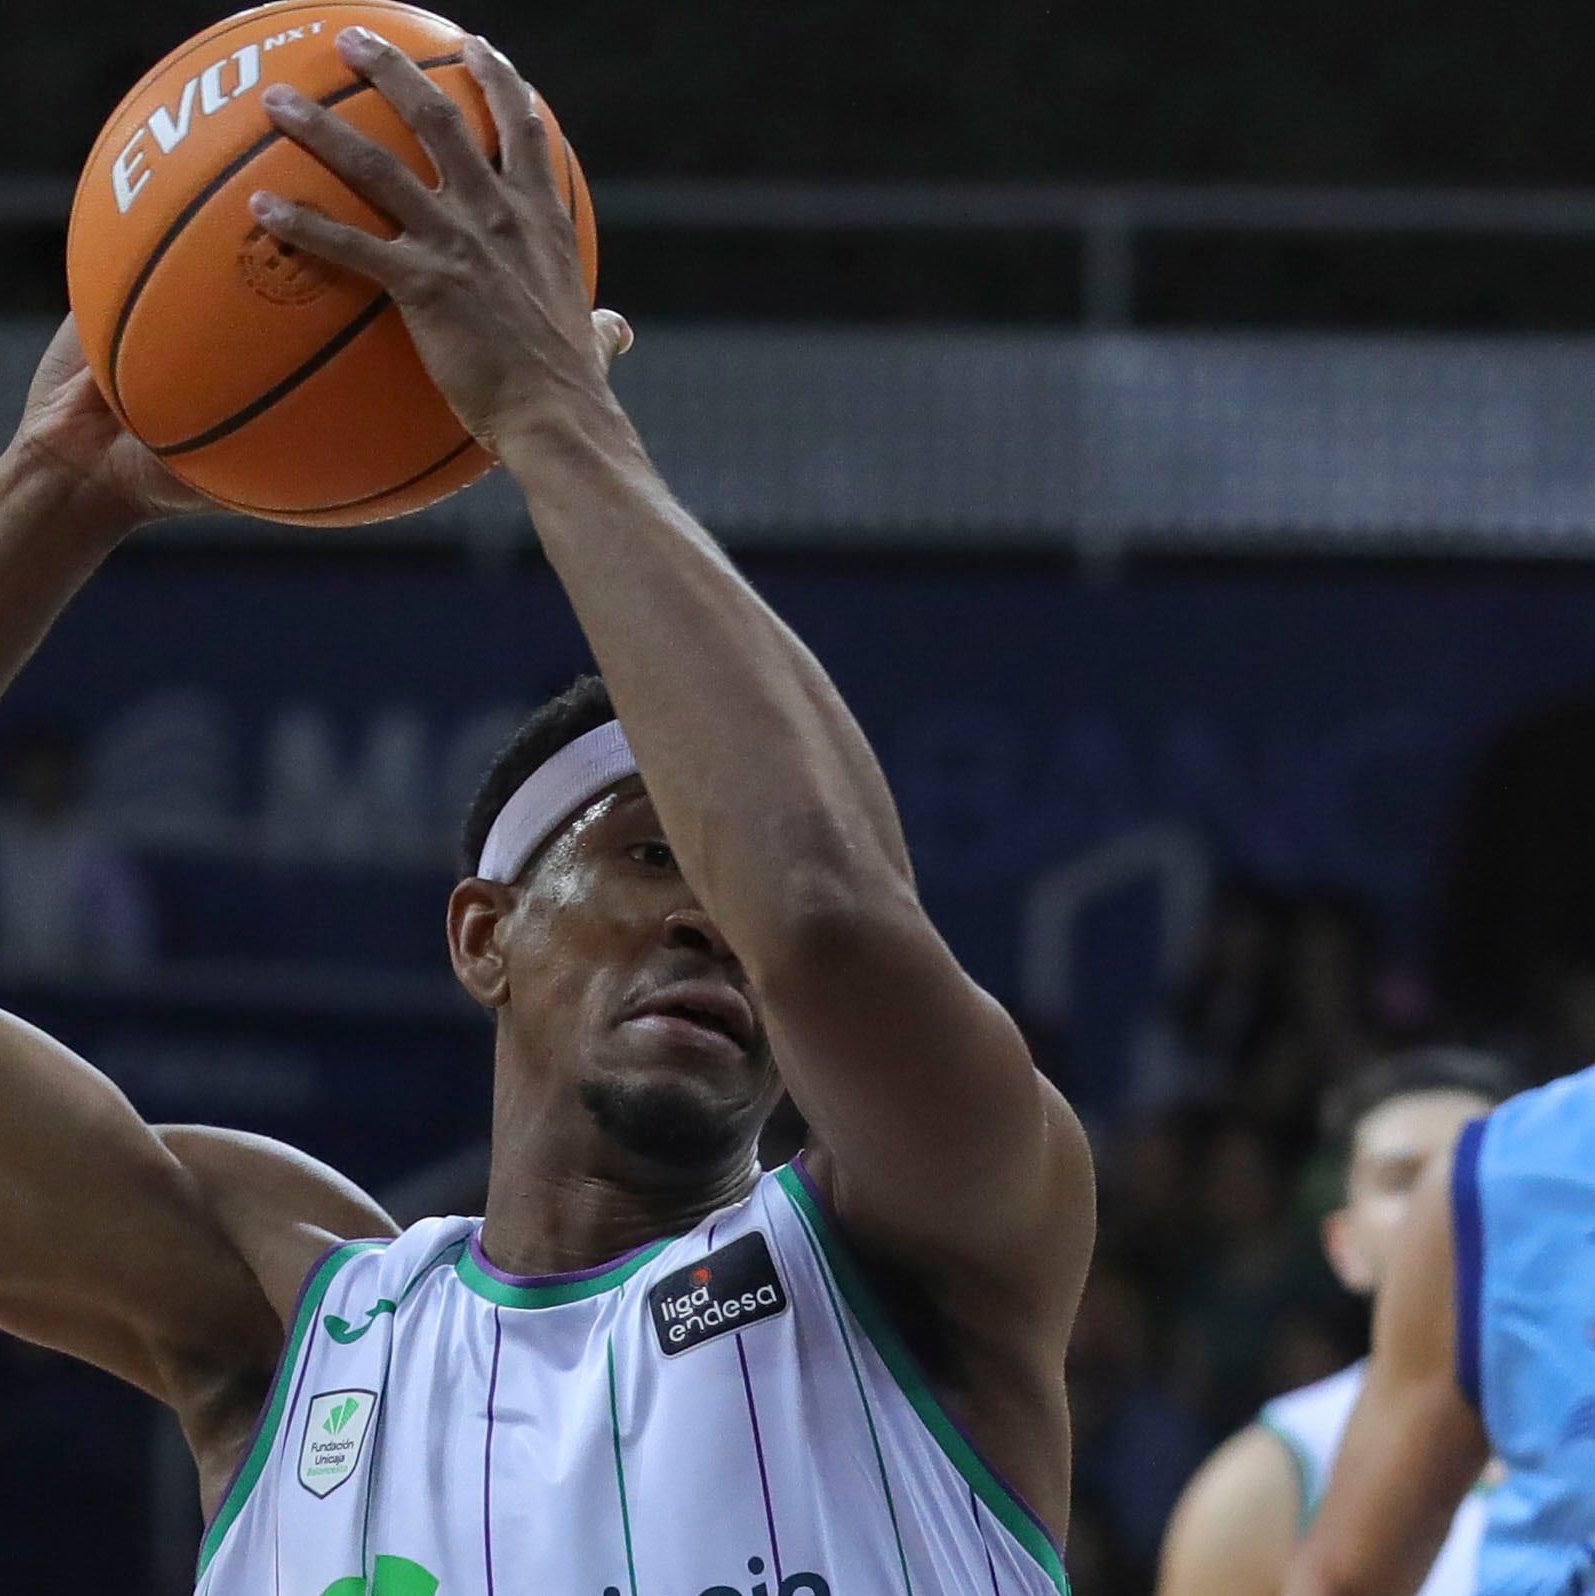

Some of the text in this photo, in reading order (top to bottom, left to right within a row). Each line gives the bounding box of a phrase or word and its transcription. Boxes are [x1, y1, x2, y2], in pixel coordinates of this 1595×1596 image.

[110, 19, 327, 214] EVO NXT
[660, 1286, 709, 1321] liga
[669, 1284, 777, 1342] endesa
[315, 1452, 345, 1466] Unicaja
